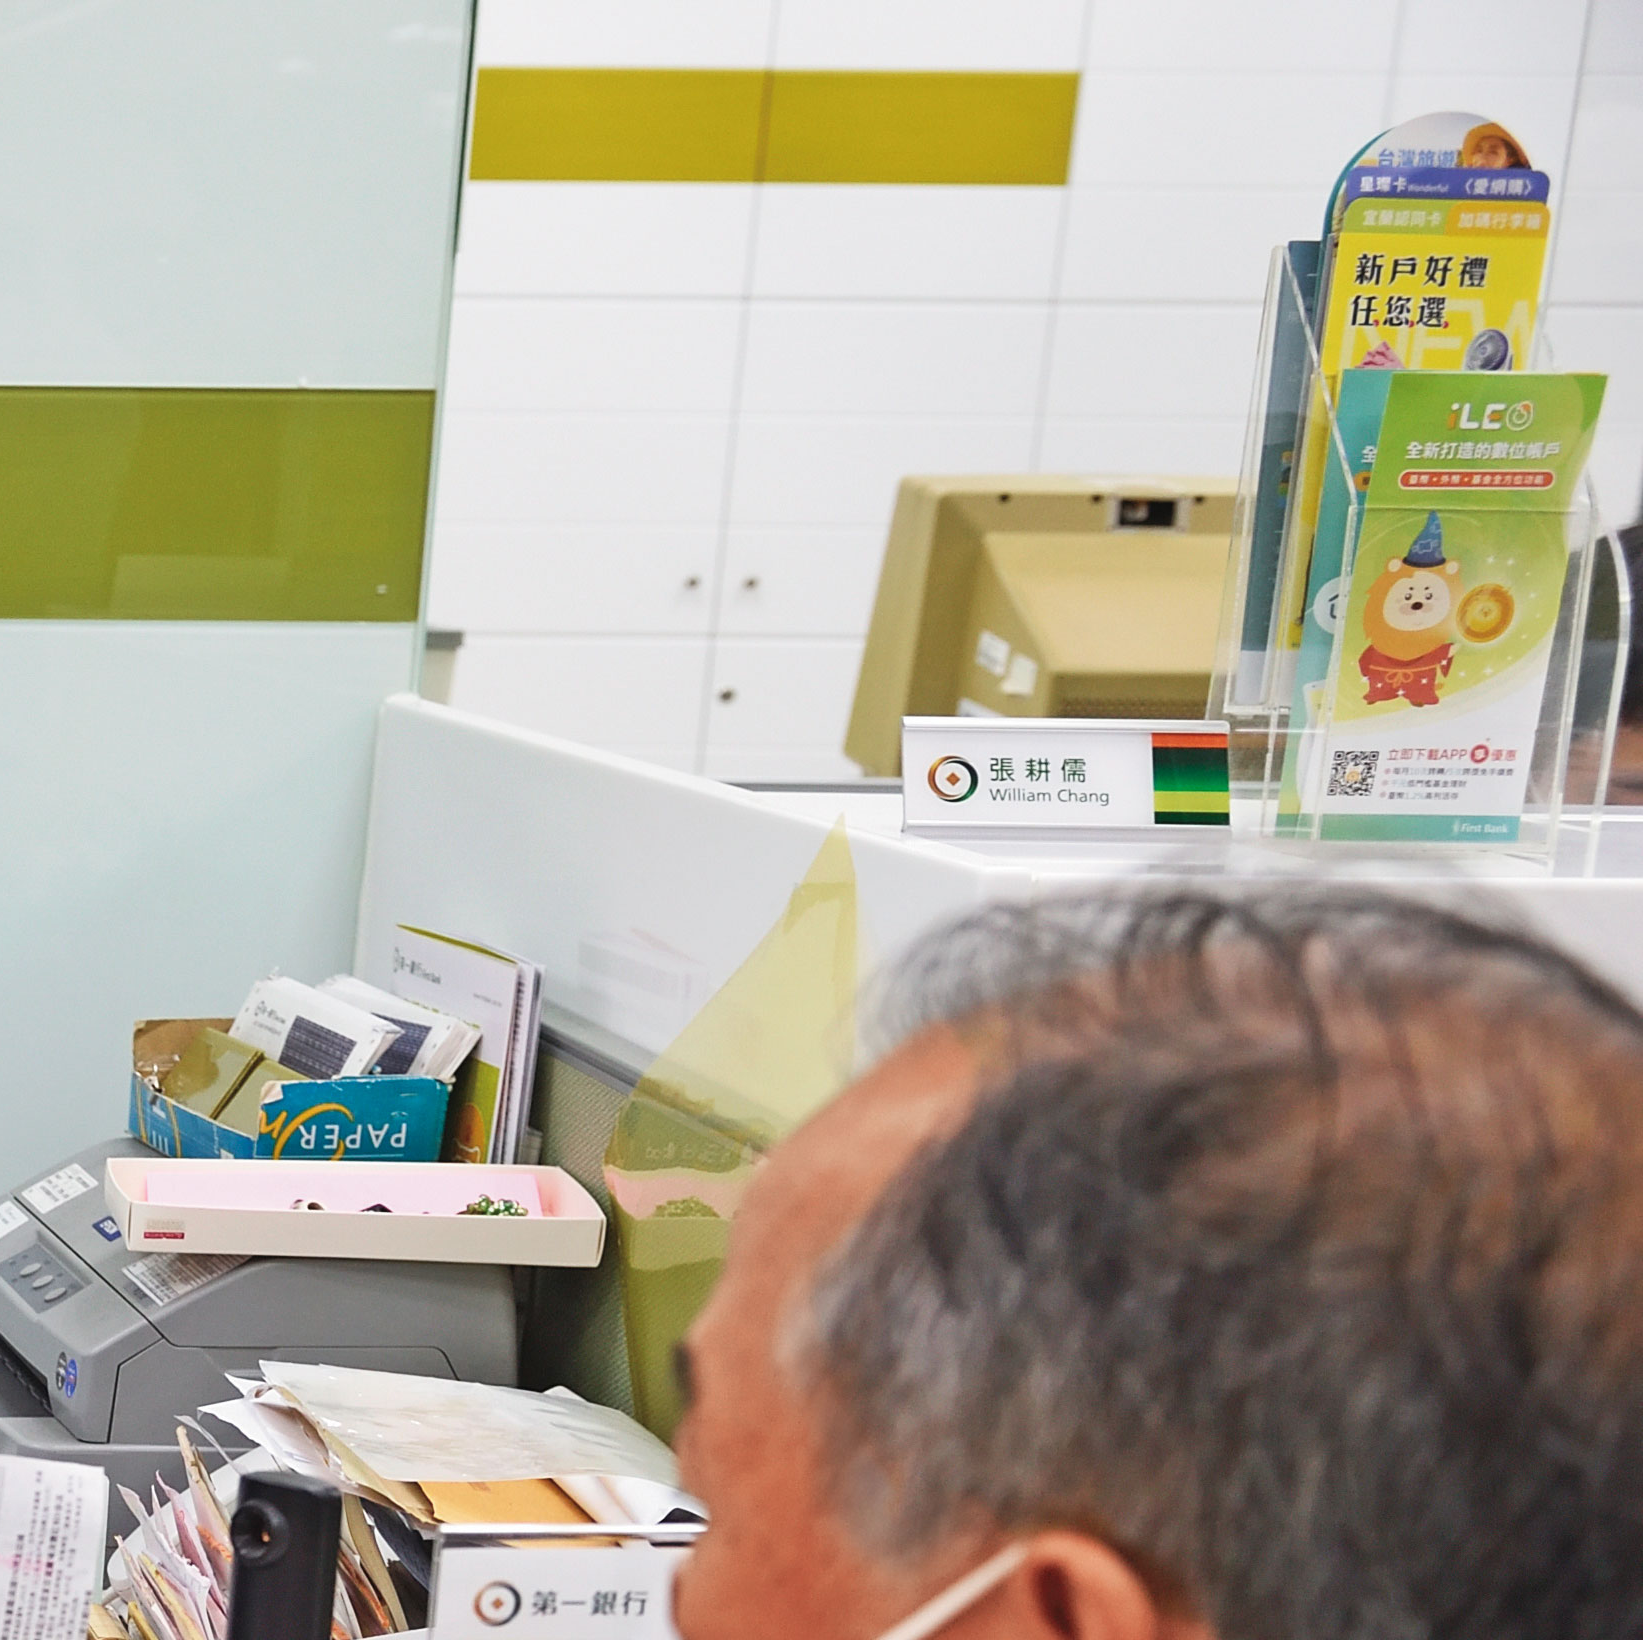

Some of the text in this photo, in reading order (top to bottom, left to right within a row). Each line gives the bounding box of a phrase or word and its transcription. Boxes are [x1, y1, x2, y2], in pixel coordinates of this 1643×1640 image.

[1354, 253, 1489, 288] 新戶好禮
[989, 788, 1110, 806] William Chang
[1460, 823, 1508, 833] First Bank
[299, 1122, 408, 1149] PAPER
[531, 1590, 649, 1616] 第一銀行
